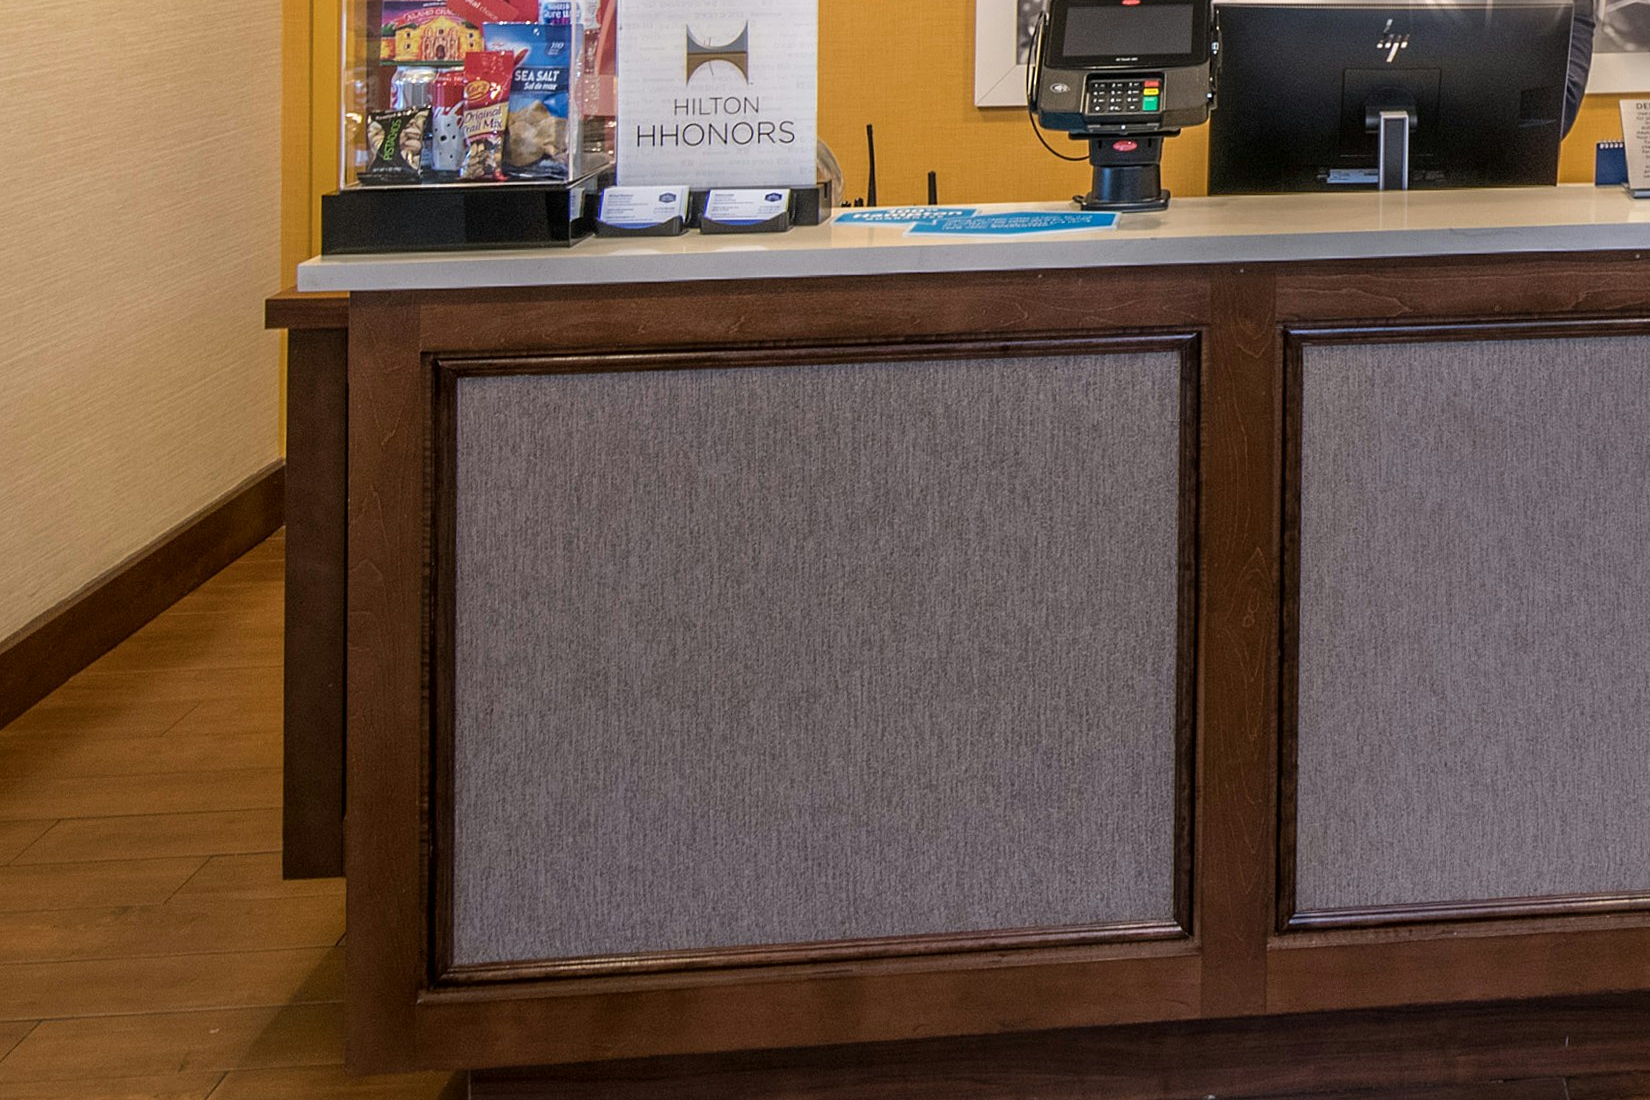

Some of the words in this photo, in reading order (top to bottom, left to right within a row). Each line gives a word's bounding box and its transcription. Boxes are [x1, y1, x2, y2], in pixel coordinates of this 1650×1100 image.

[514, 70, 534, 82] SEA
[536, 70, 559, 82] SALT
[674, 96, 760, 116] HILTON
[465, 107, 502, 122] Original
[484, 118, 502, 128] Mix
[637, 120, 795, 147] HHONORS
